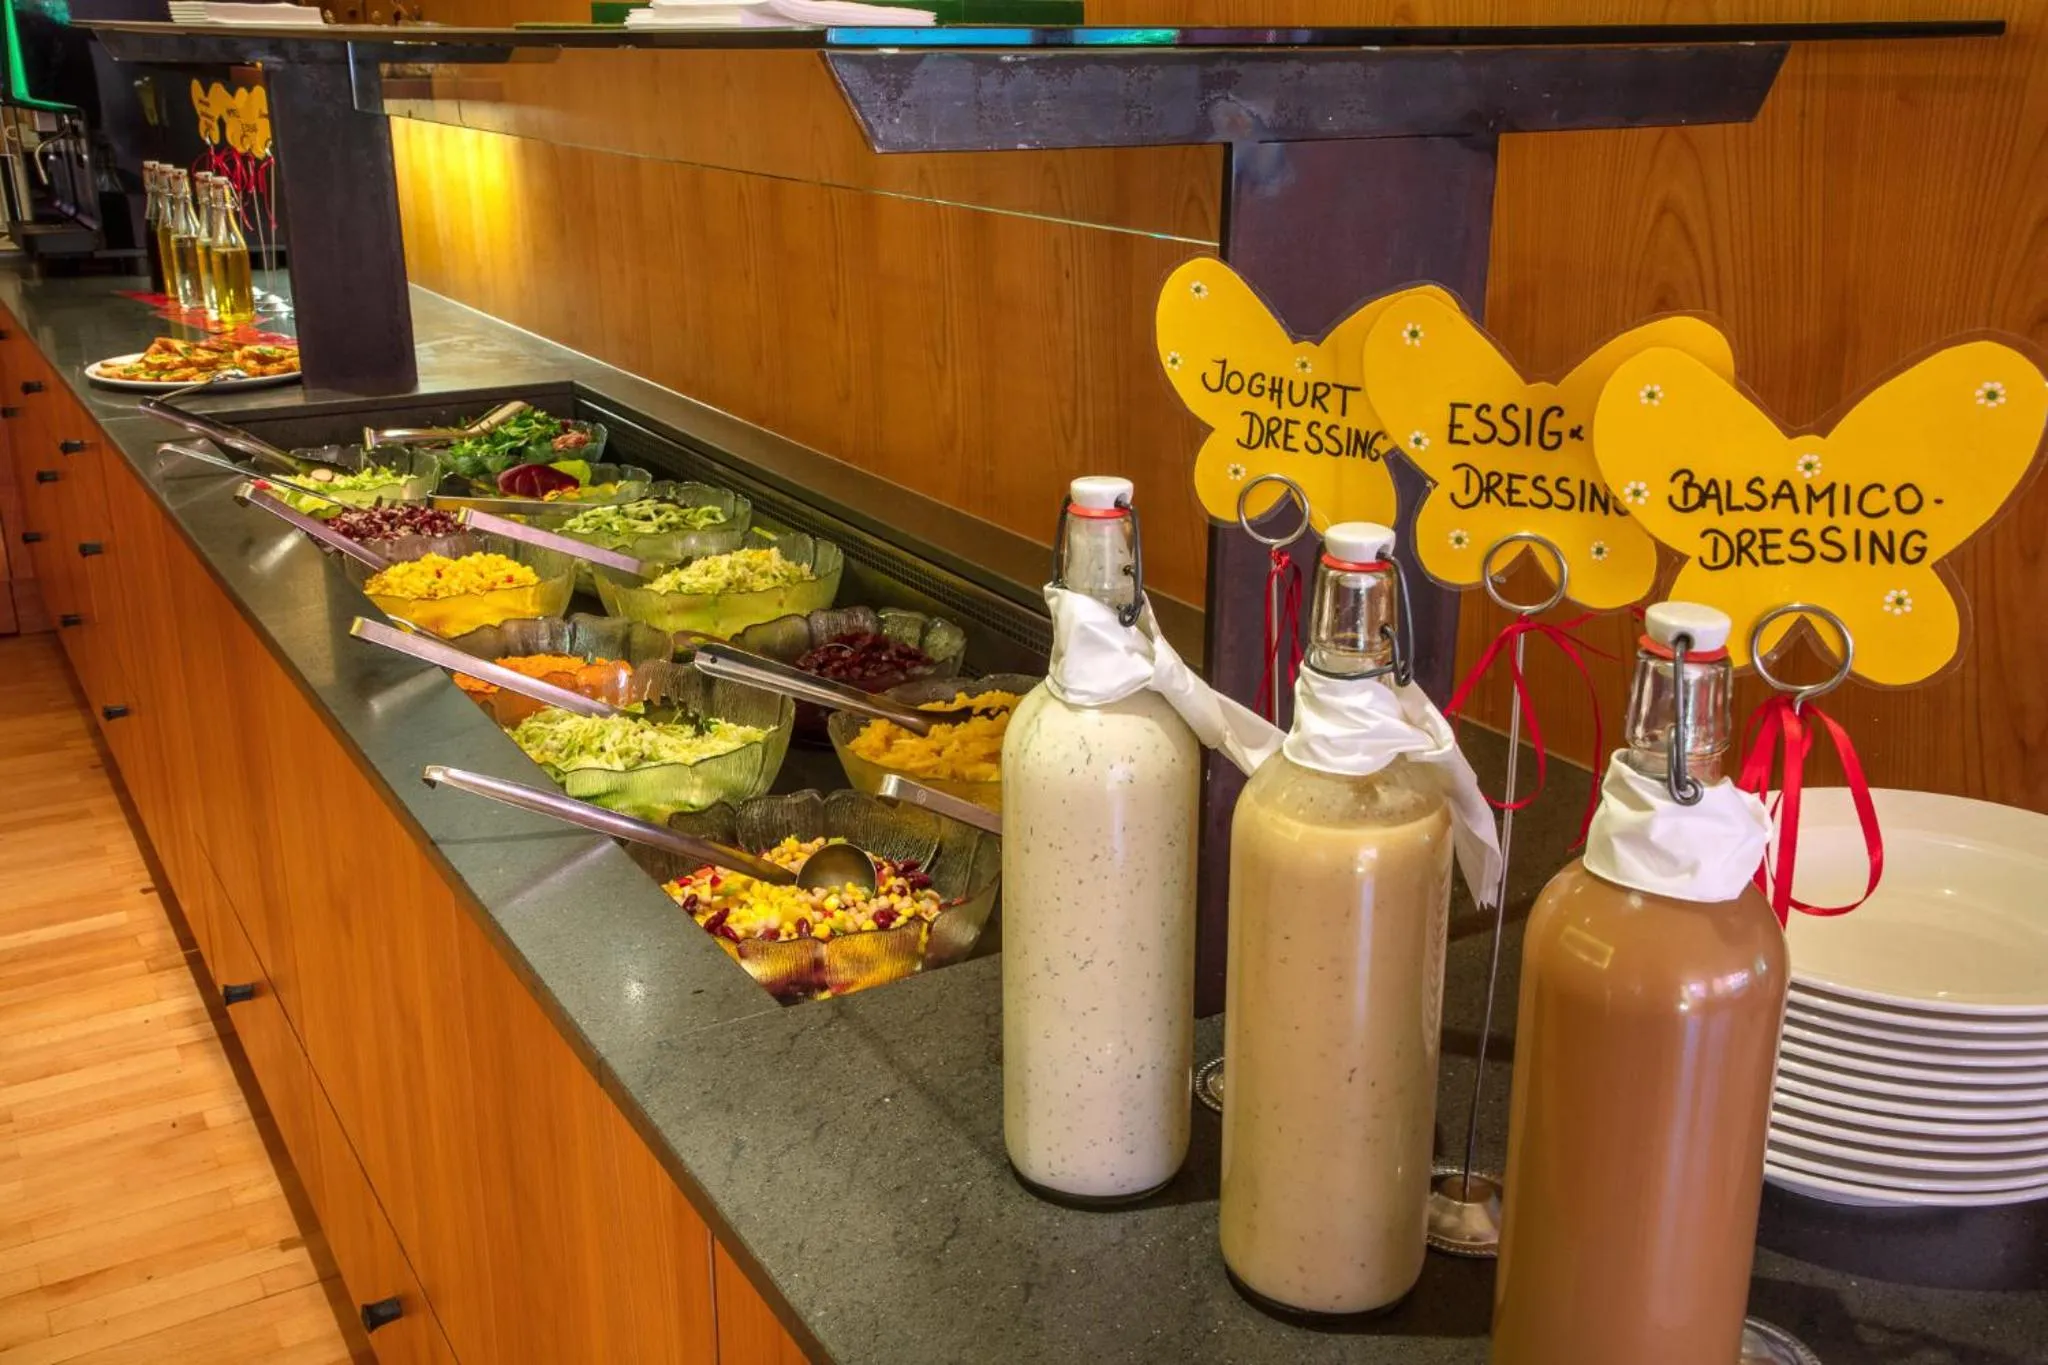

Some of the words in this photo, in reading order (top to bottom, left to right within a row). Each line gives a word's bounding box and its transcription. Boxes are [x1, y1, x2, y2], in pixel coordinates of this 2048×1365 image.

[1201, 358, 1362, 417] JOGHURT
[1236, 410, 1388, 462] DRESSING
[1698, 525, 1928, 571] DRESSING
